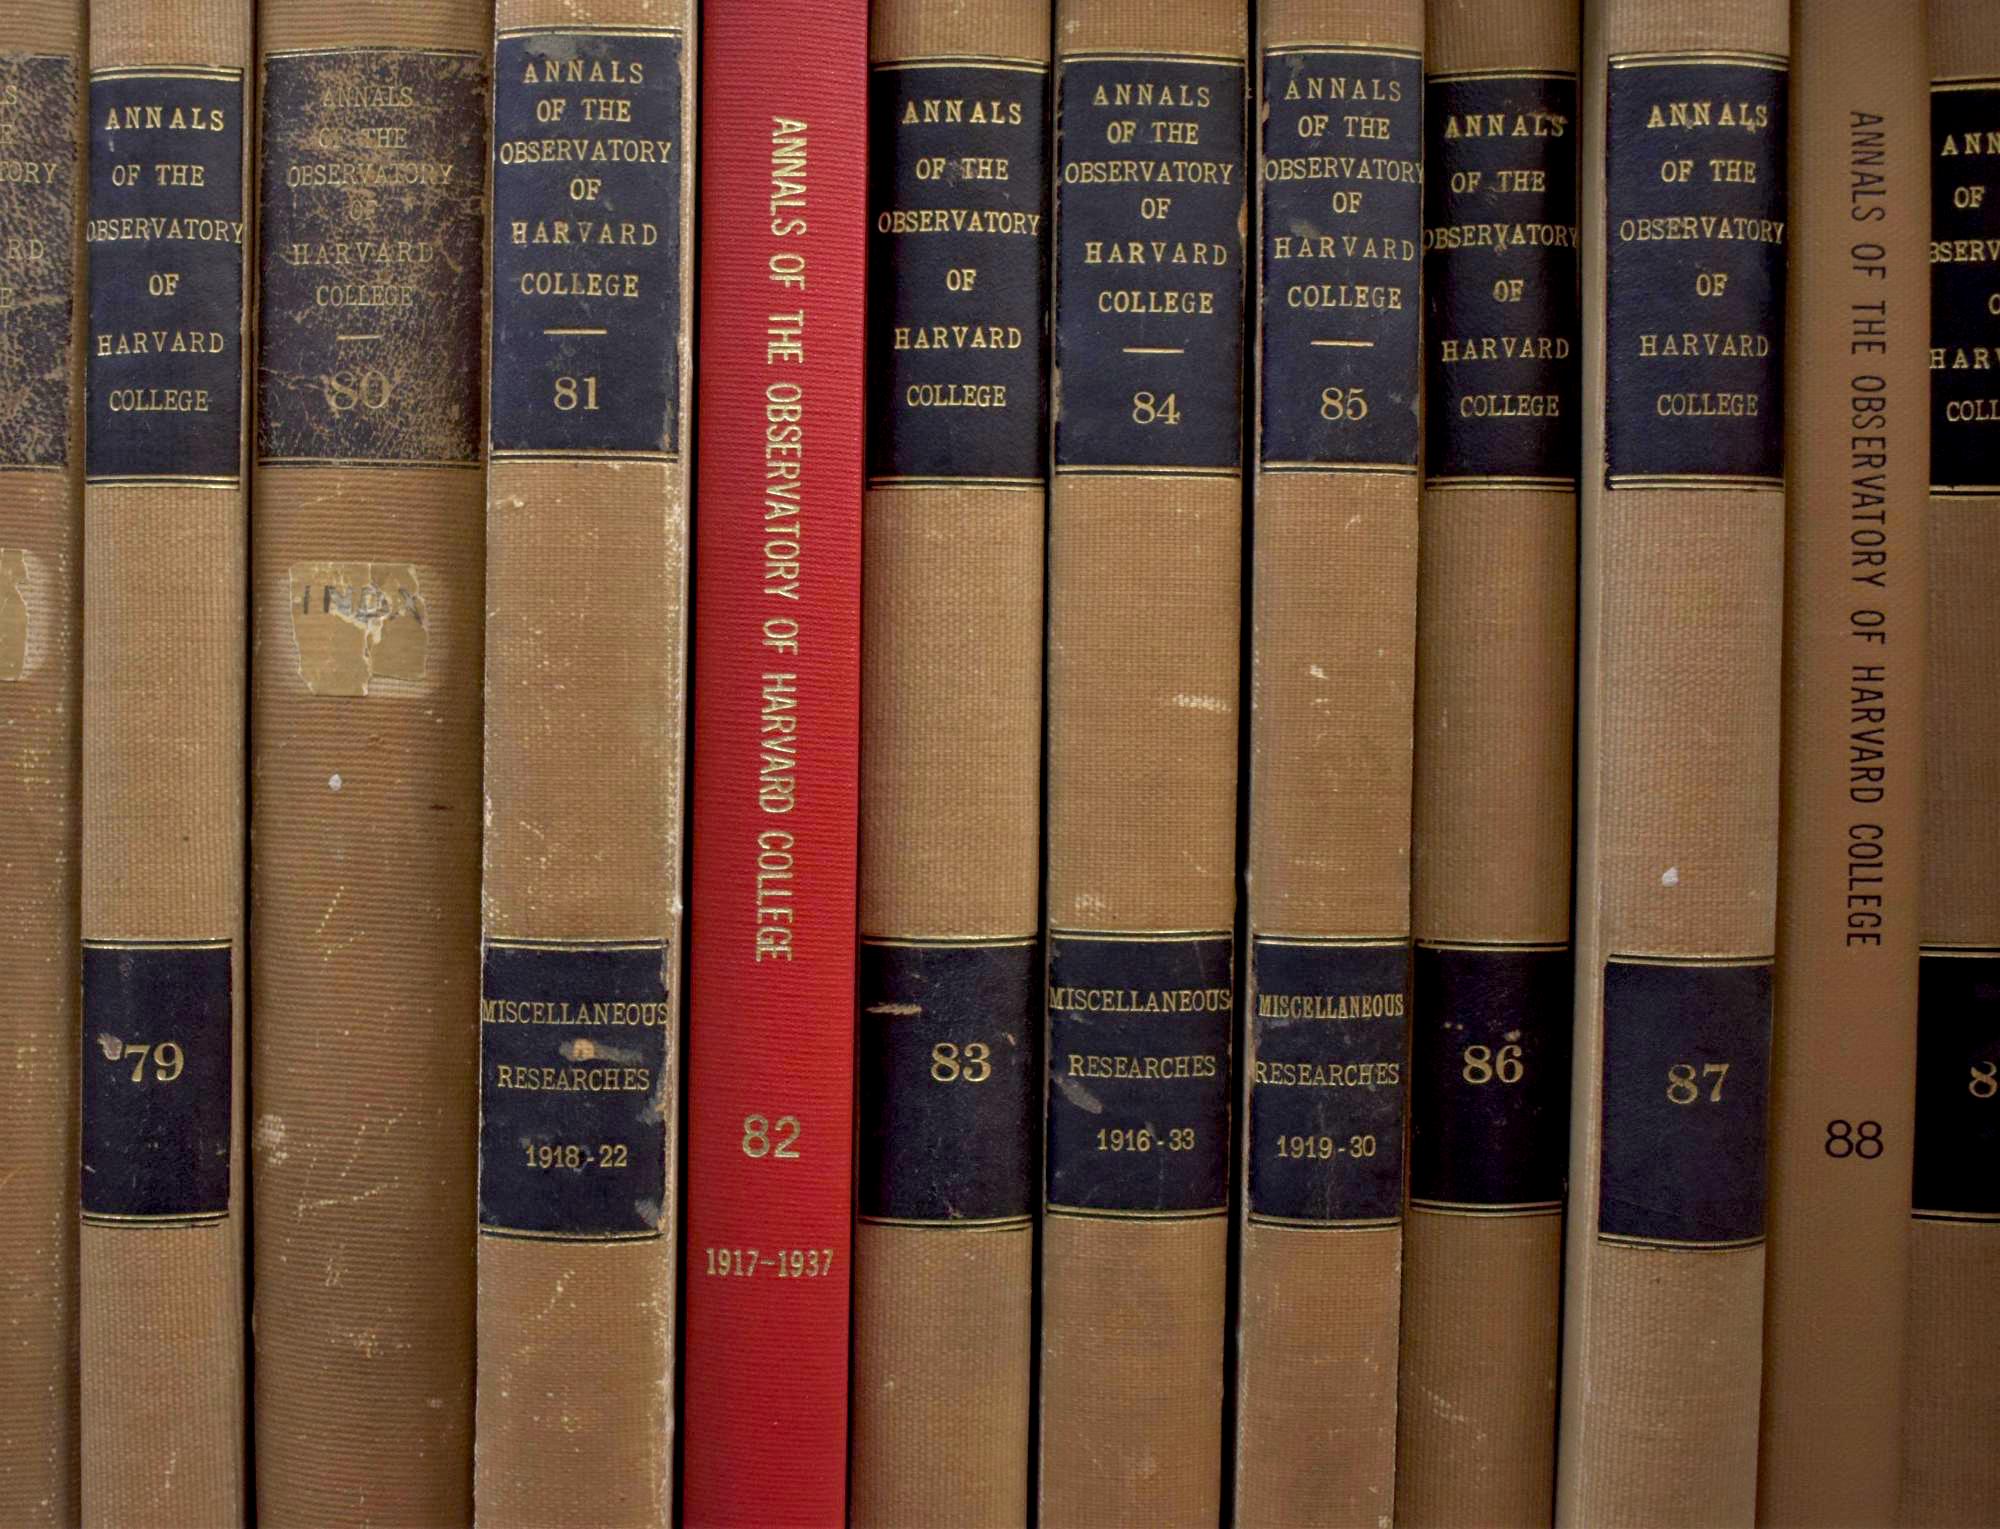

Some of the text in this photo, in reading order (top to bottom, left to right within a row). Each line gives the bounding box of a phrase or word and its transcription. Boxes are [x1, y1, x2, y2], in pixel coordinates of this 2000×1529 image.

[523, 60, 643, 84] ANNALS
[322, 86, 414, 108] ANNALS
[1094, 84, 1210, 108] ANNALS
[1284, 77, 1401, 102] ANNALS
[105, 107, 225, 132] ANNALS
[537, 98, 631, 123] OF THE
[902, 100, 1022, 125] ANNALS
[1647, 102, 1768, 128] ANNALS
[1107, 121, 1200, 145] OF THE
[1298, 115, 1390, 140] OF THE
[1445, 115, 1565, 138] ANNALS
[500, 140, 672, 165] OBSERVATORY
[112, 164, 205, 187] OF THE
[288, 163, 453, 188] OBSERVATORY
[916, 157, 1009, 181] OF THE
[1064, 161, 1234, 185] OBSERVATORY
[1265, 157, 1424, 183] OBSERVATORY
[1661, 160, 1757, 184] OF THE
[570, 178, 601, 200] OF
[1451, 171, 1546, 194] OF THE
[1140, 198, 1171, 220] OF
[1332, 191, 1362, 213] OF
[1954, 185, 1986, 208] OF
[87, 217, 243, 244] OBSERVATORY
[512, 221, 658, 246] HARVARD
[878, 210, 1041, 236] OBSERVATORY
[1619, 217, 1785, 245] OBSERVATORY
[293, 242, 433, 265] HARVARD
[1084, 241, 1228, 266] HARVARD
[1273, 236, 1415, 262] HARVARD
[149, 273, 180, 296] OF
[521, 272, 639, 298] COLLEGE
[946, 269, 977, 291] OF
[1492, 280, 1525, 302] OF
[1695, 273, 1729, 297] OF
[317, 285, 414, 306] COLLEGE
[1099, 290, 1214, 314] COLLEGE
[1287, 285, 1402, 310] COLLEGE
[97, 331, 224, 356] HARVARD
[894, 326, 1022, 350] HARVARD
[1441, 337, 1570, 363] HARVARD
[1639, 334, 1769, 358] HARVARD
[109, 389, 209, 412] COLLEGE
[330, 371, 391, 410] 80
[553, 377, 599, 411] 81
[906, 385, 1007, 407] COLLEGE
[1132, 391, 1181, 425] 84
[1320, 387, 1368, 421] 85
[1460, 394, 1560, 418] COLLEGE
[1657, 393, 1759, 417] COLLEGE
[755, 116, 808, 962] ANNALS OF THE OBSERVATORY OF HARVARD COLLEGE
[1846, 111, 1887, 948] ANNALS OF THE OBSERVATORY OF HARVARD COLLEGE
[482, 1000, 668, 1026] MISCELLANEOUS
[1049, 988, 1231, 1013] MISCELLANEOUS
[1258, 993, 1404, 1019] MISCELLANEOUS
[124, 1042, 184, 1082] 79
[931, 1042, 992, 1082] 83
[1068, 1054, 1216, 1079] RESEARCHES
[1255, 1061, 1400, 1086] RESEARCHES
[1463, 1045, 1524, 1084] 86
[497, 1065, 650, 1092] RESEARCHES
[1666, 1063, 1730, 1105] 87
[1968, 1061, 1998, 1098] 8
[742, 1114, 801, 1159] 82
[1824, 1119, 1884, 1159] 88
[705, 1248, 834, 1277] 1917-1937
